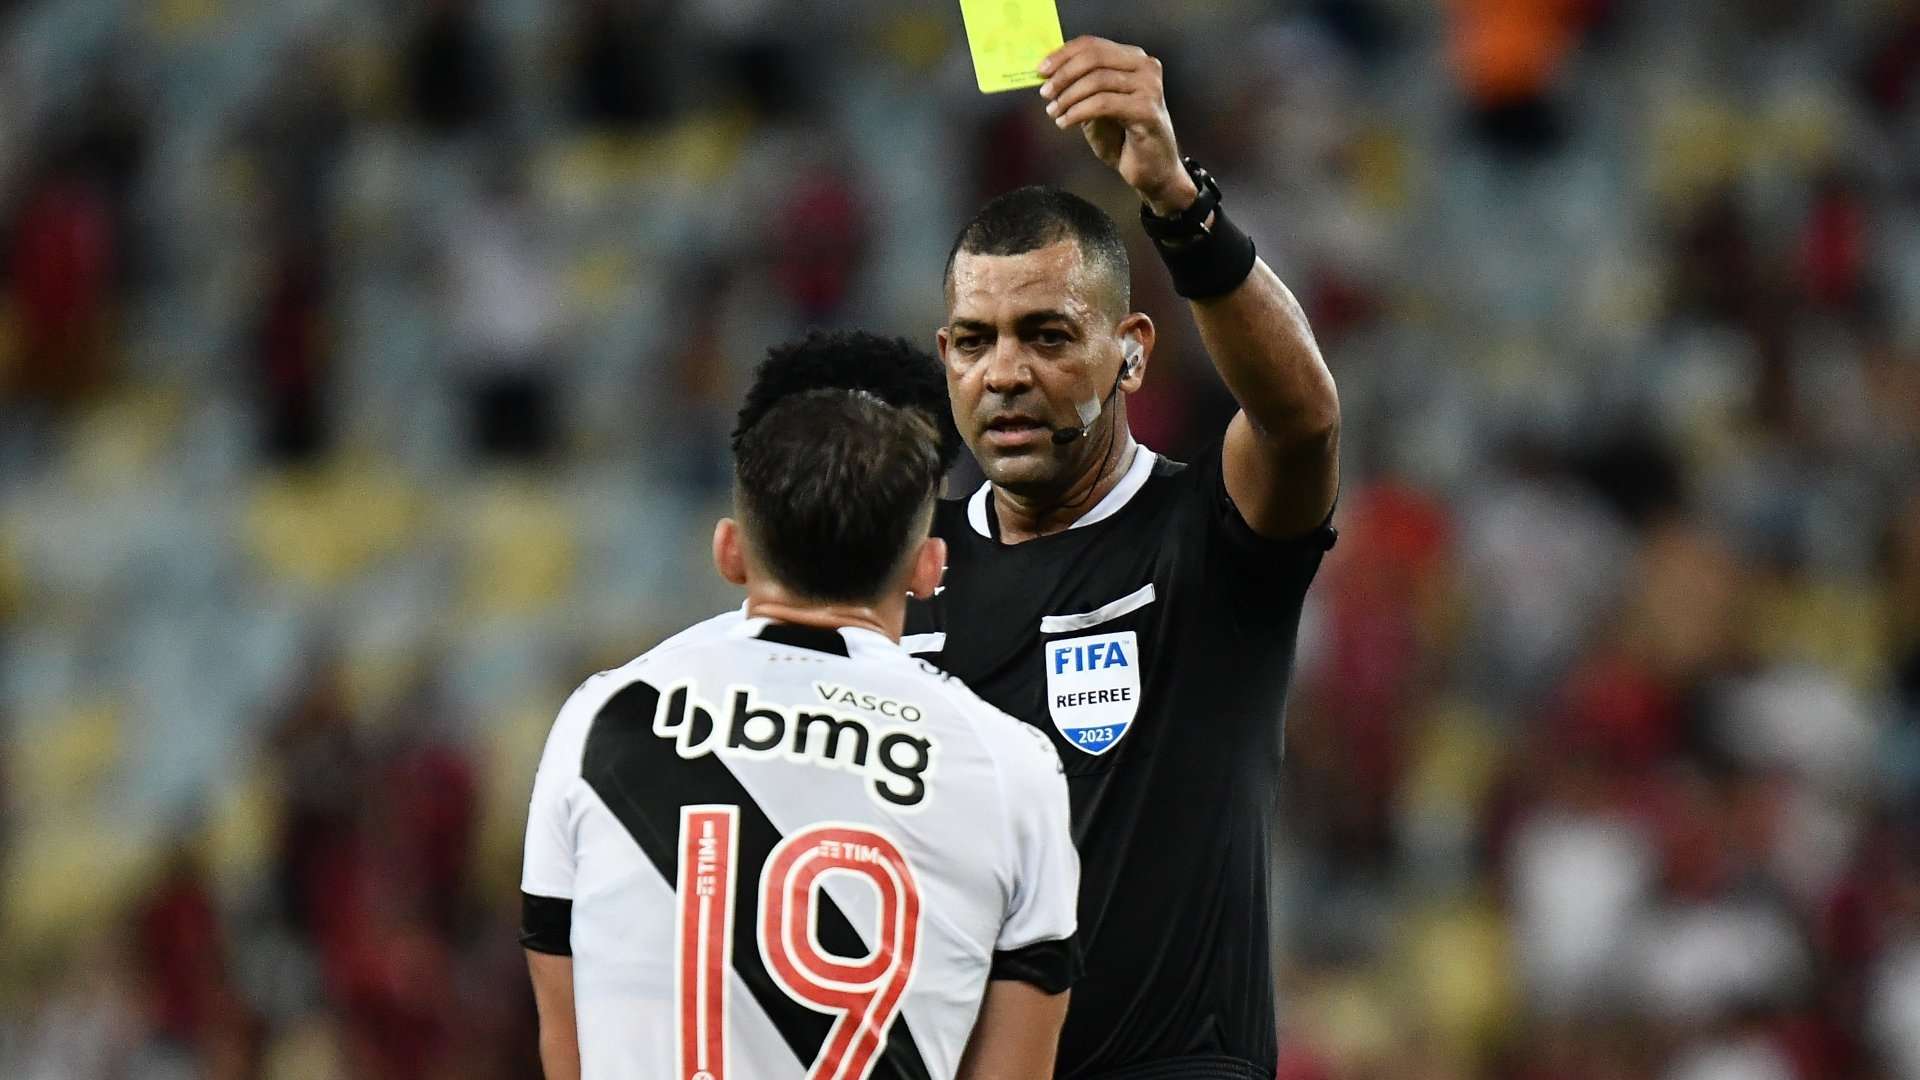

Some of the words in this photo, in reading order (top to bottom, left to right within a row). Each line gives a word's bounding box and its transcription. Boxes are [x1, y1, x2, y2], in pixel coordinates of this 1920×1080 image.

[1055, 641, 1129, 674] FIFA
[817, 684, 922, 723] VASCO
[1056, 687, 1132, 708] REFEREE
[726, 691, 932, 806] bmg
[1078, 727, 1114, 744] 2023
[841, 841, 880, 865] TIM
[675, 804, 925, 1080] 19
